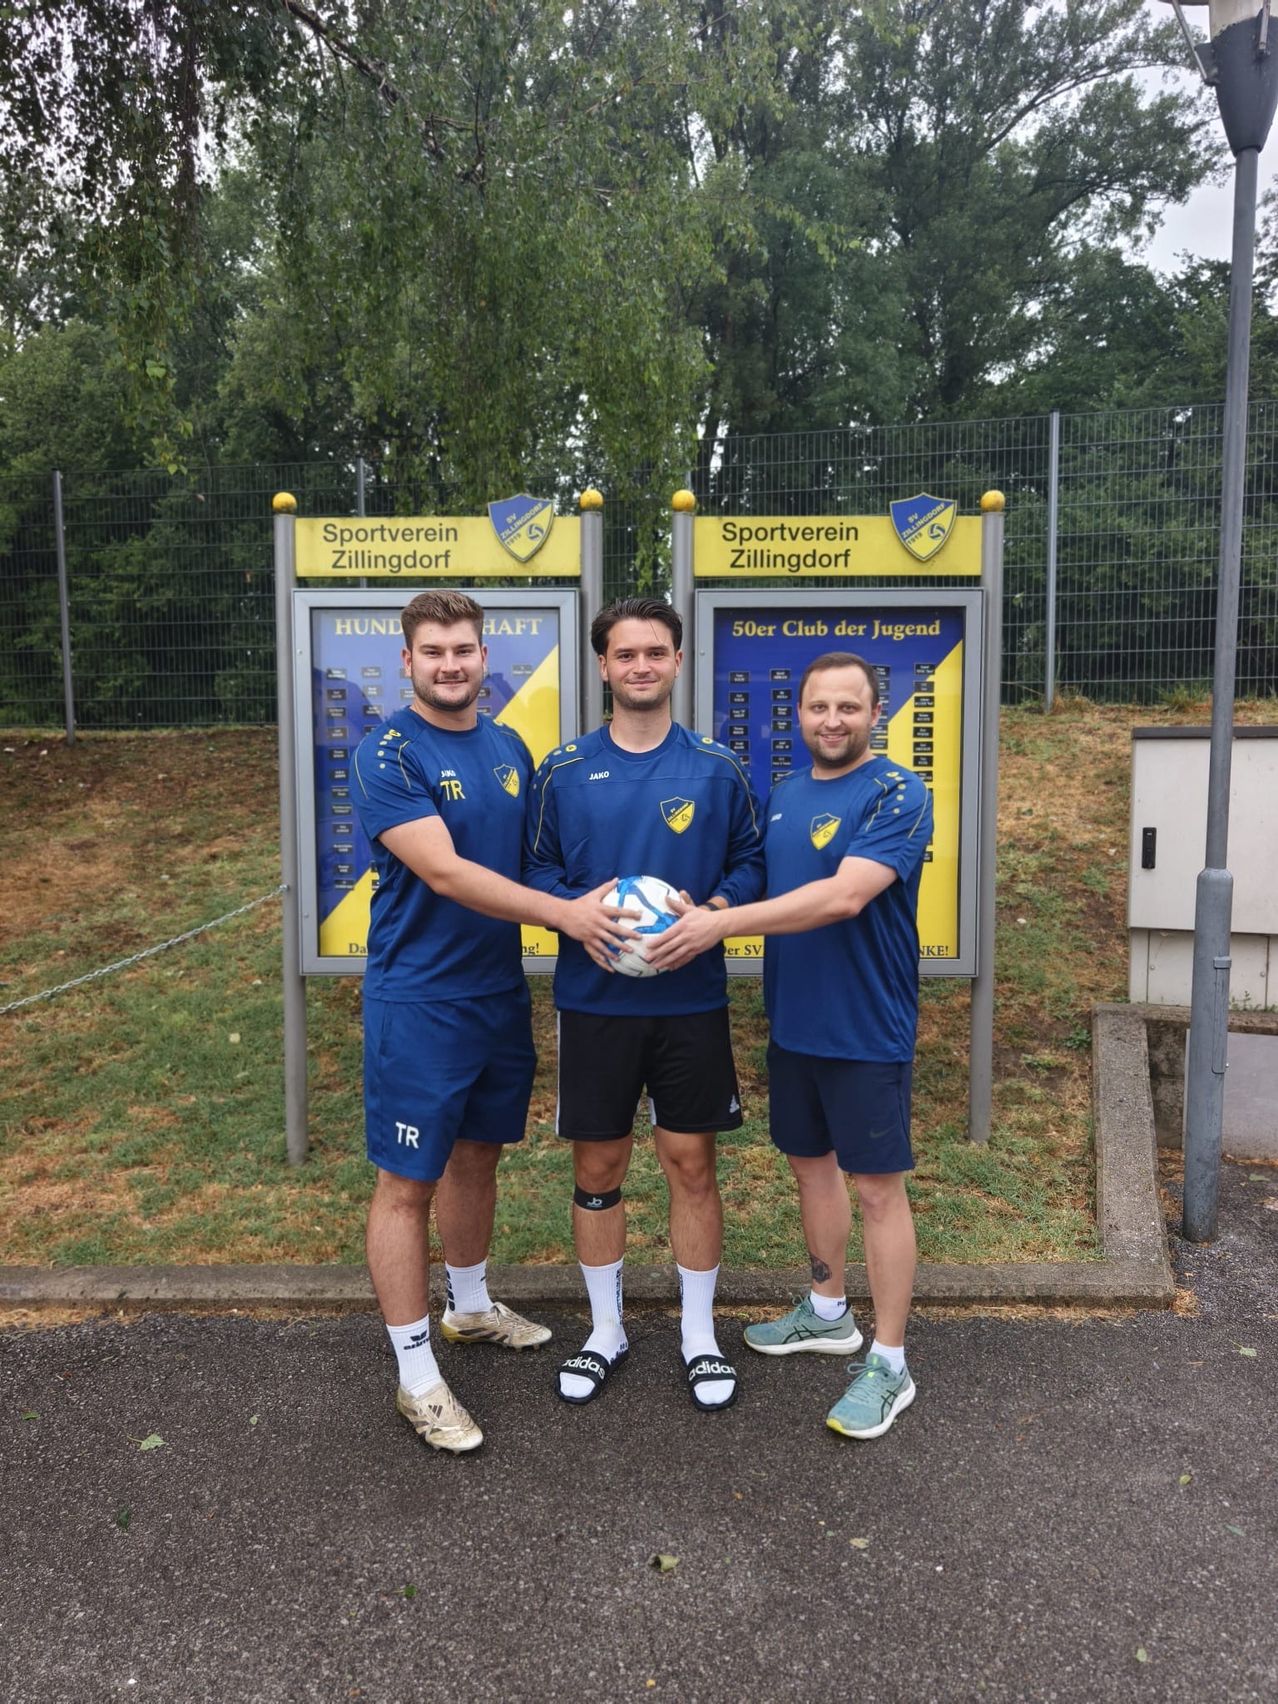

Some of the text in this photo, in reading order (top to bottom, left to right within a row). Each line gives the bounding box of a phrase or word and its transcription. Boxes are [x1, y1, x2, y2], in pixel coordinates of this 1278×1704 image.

[901, 502, 945, 539] ZILLINGDORF
[323, 523, 458, 546] Sportverein
[722, 522, 859, 545] Sportverein
[331, 550, 451, 573] Zillingdorf
[730, 549, 851, 572] Zillingdorf
[732, 620, 941, 640] 50er Club der Jugend
[589, 770, 610, 781] JAKO
[440, 779, 466, 801] TR
[395, 1121, 420, 1149] TR
